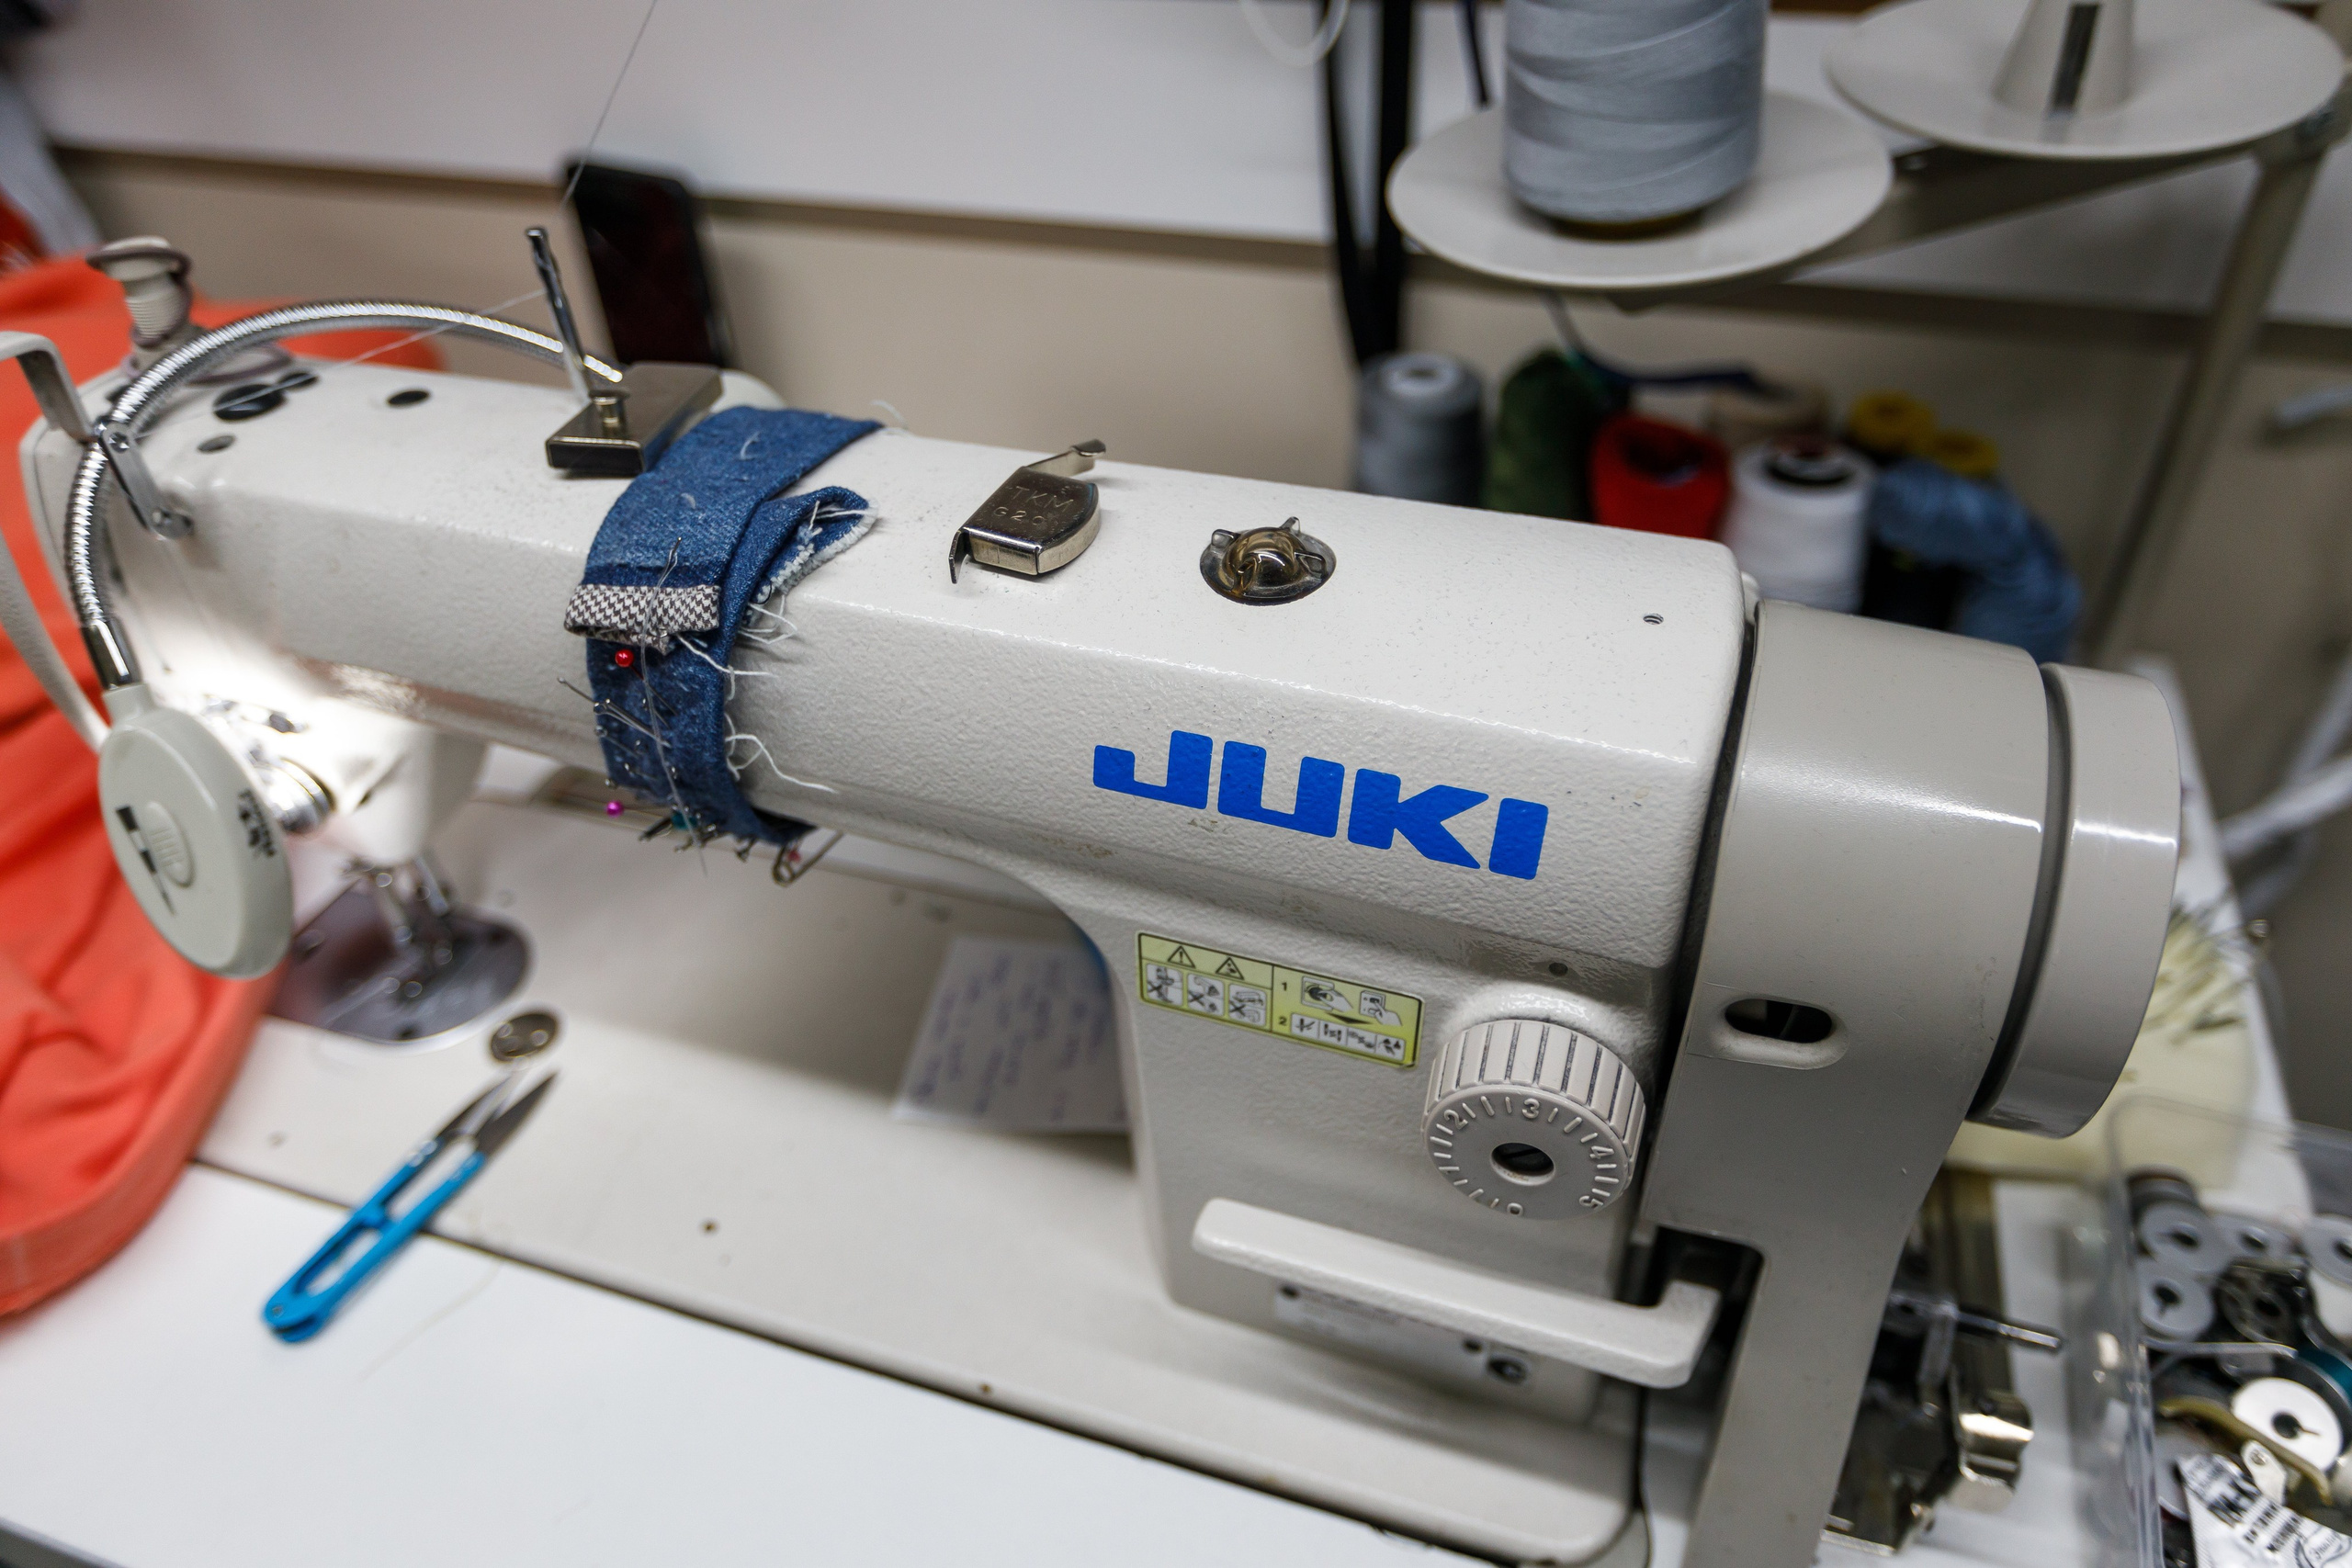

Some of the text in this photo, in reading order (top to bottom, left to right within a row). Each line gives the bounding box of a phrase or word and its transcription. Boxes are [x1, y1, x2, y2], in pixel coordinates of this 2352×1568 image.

[1012, 485, 1074, 513] TKM
[1093, 730, 1548, 880] JUKI
[1282, 982, 1287, 991] 1
[1279, 1016, 1287, 1026] 2
[1521, 1098, 1540, 1119] 3
[1443, 1109, 1468, 1130] 2
[1589, 1145, 1615, 1160] 4
[1507, 1202, 1523, 1216] 0
[1578, 1195, 1604, 1211] 5
